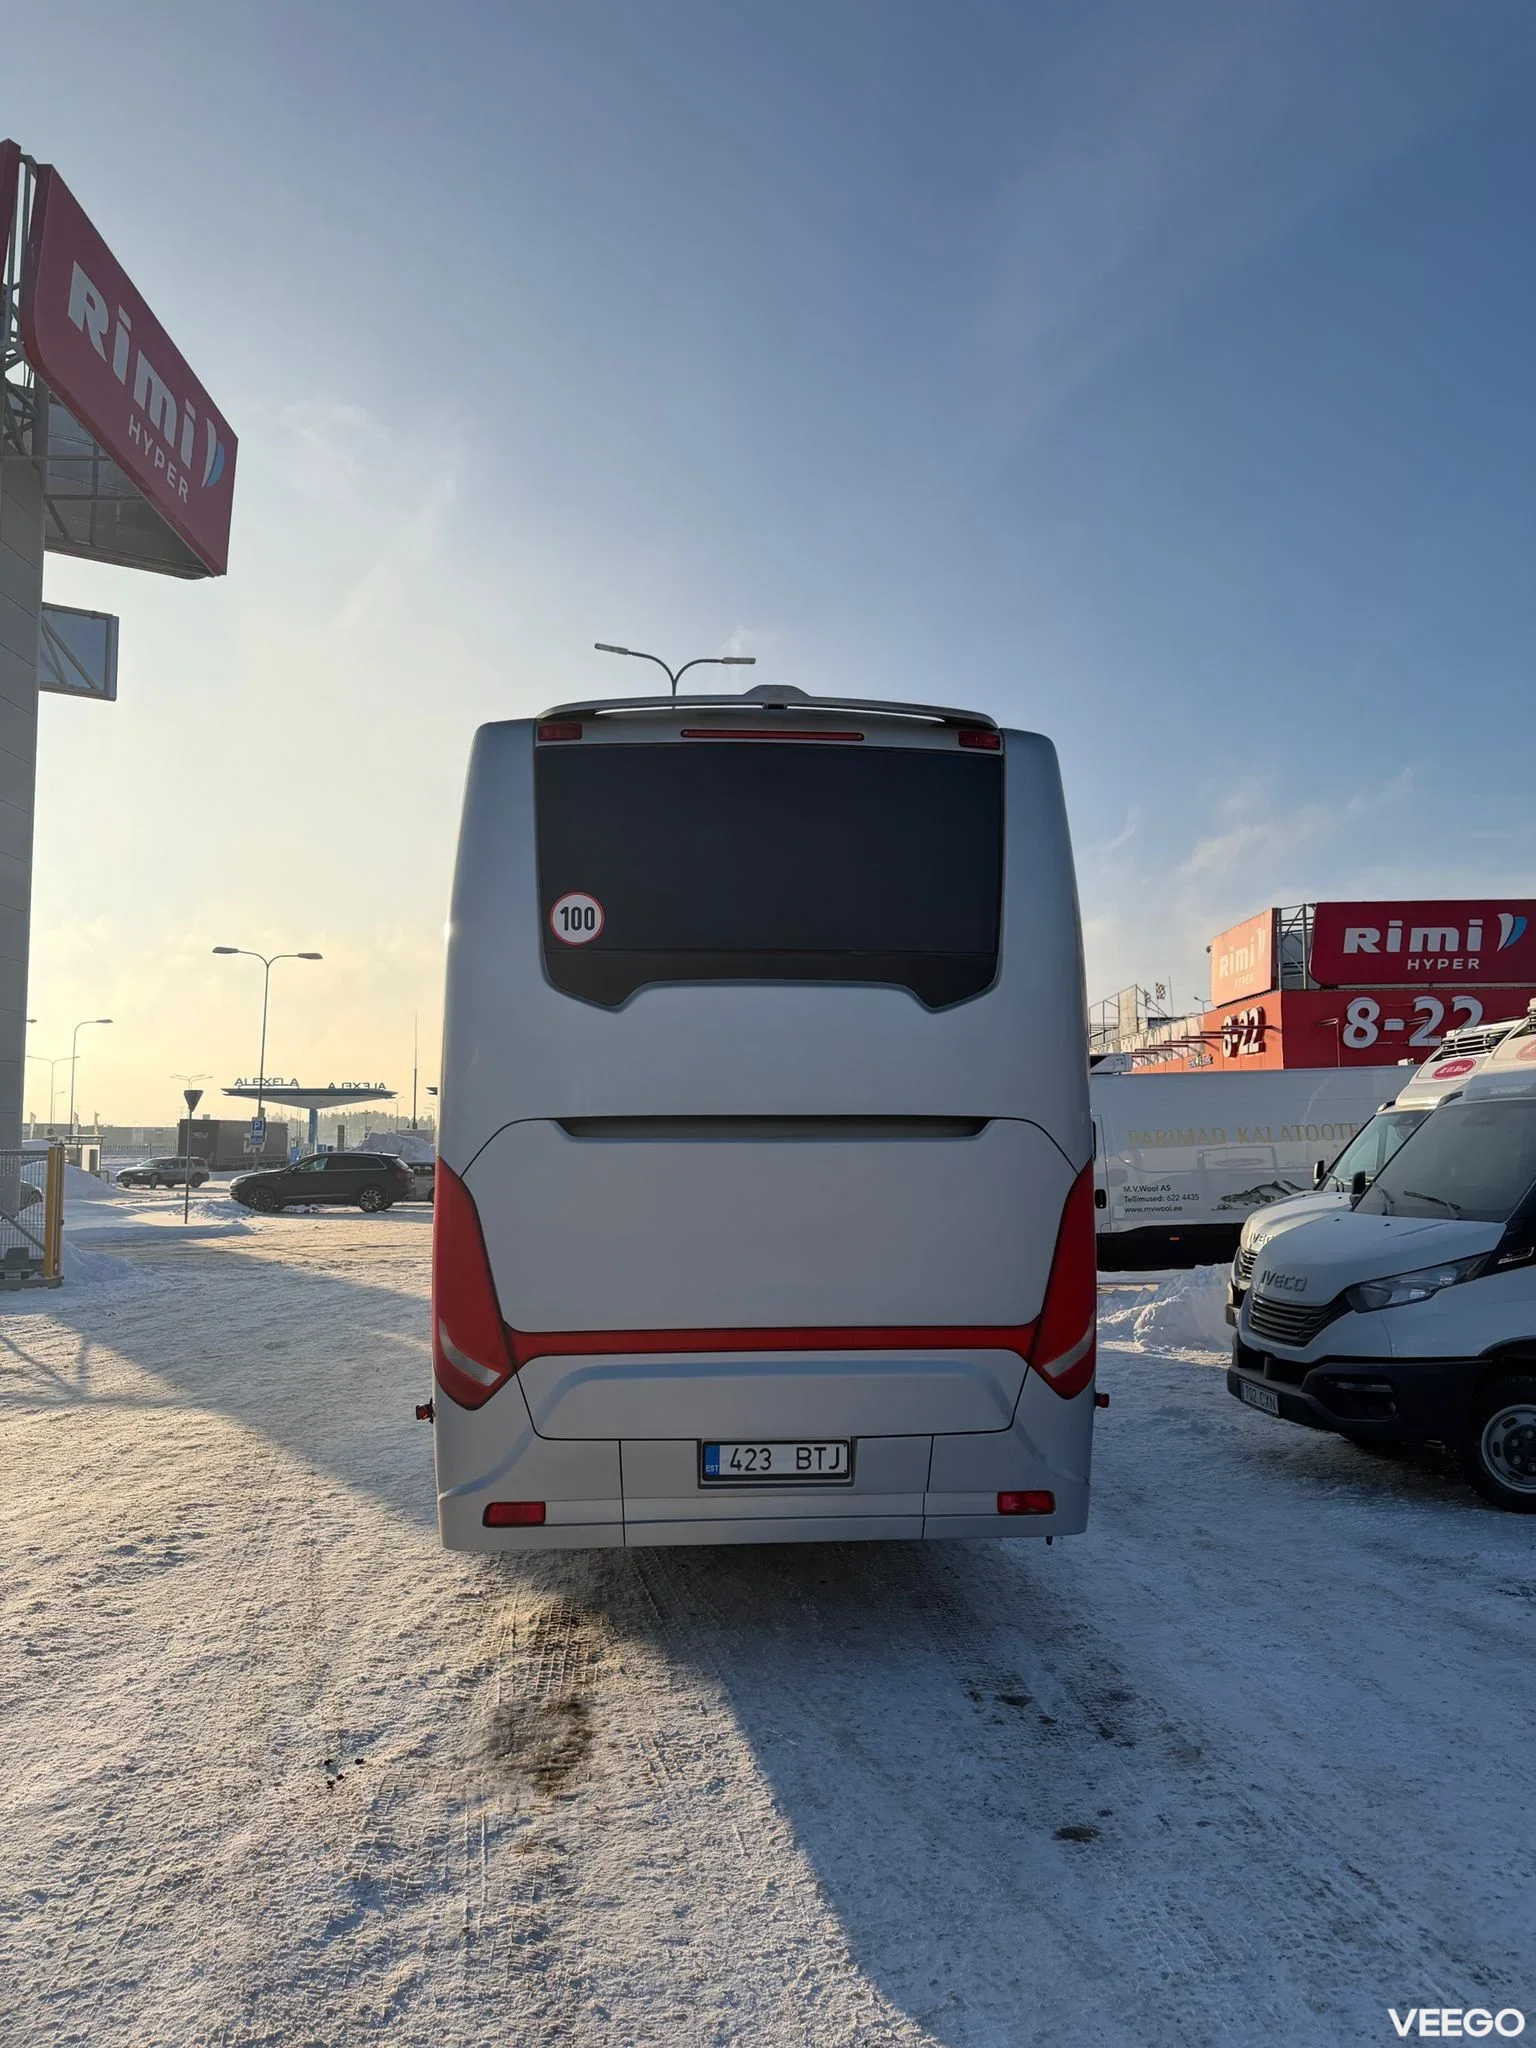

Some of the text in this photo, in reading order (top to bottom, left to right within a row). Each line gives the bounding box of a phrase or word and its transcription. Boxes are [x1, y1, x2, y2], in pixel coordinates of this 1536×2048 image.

[68, 260, 196, 470] Rimi
[128, 413, 190, 504] HYPER
[560, 906, 595, 931] 100
[1343, 919, 1483, 954] Rimi
[1219, 936, 1254, 979] Rimi
[1407, 958, 1480, 971] HYPER
[1222, 1005, 1262, 1058] 8-22
[1342, 996, 1483, 1049] 8-22
[234, 1077, 299, 1087] ALEXELA
[1127, 1122, 1360, 1148] PARIMAD KALATOOTE
[1124, 1194, 1165, 1202] Tellimused:
[1182, 1193, 1199, 1201] 4435
[1261, 1270, 1307, 1292] IVECO
[729, 1446, 840, 1471] 423 BTJ
